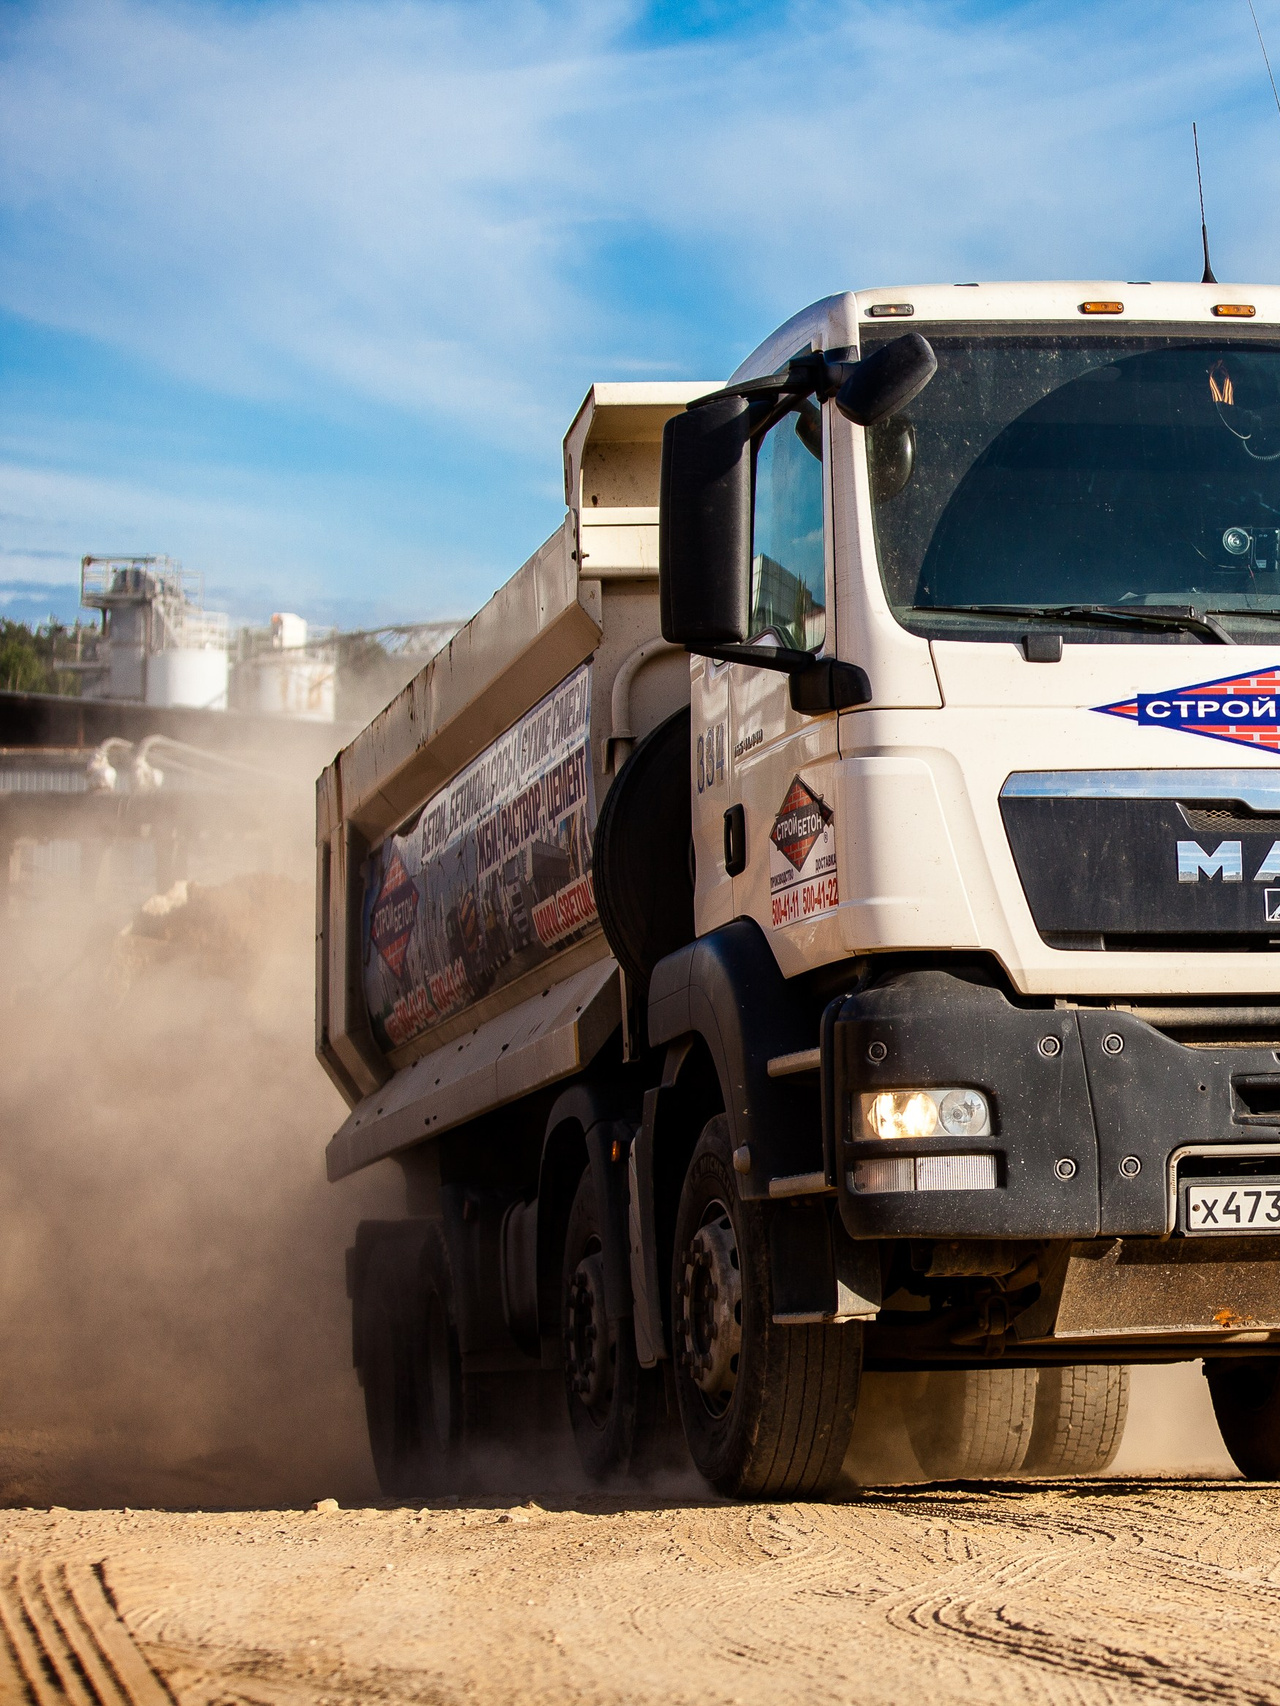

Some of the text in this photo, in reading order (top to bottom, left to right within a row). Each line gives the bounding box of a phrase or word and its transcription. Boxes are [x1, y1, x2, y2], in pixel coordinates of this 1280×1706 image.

[522, 709, 551, 775] СУХИЕ
[553, 676, 587, 749] СМЕСИ
[697, 722, 726, 796] 334
[546, 745, 587, 828] ЦЕМЕНТ
[772, 878, 839, 926] 500-41-11 500-41-22
